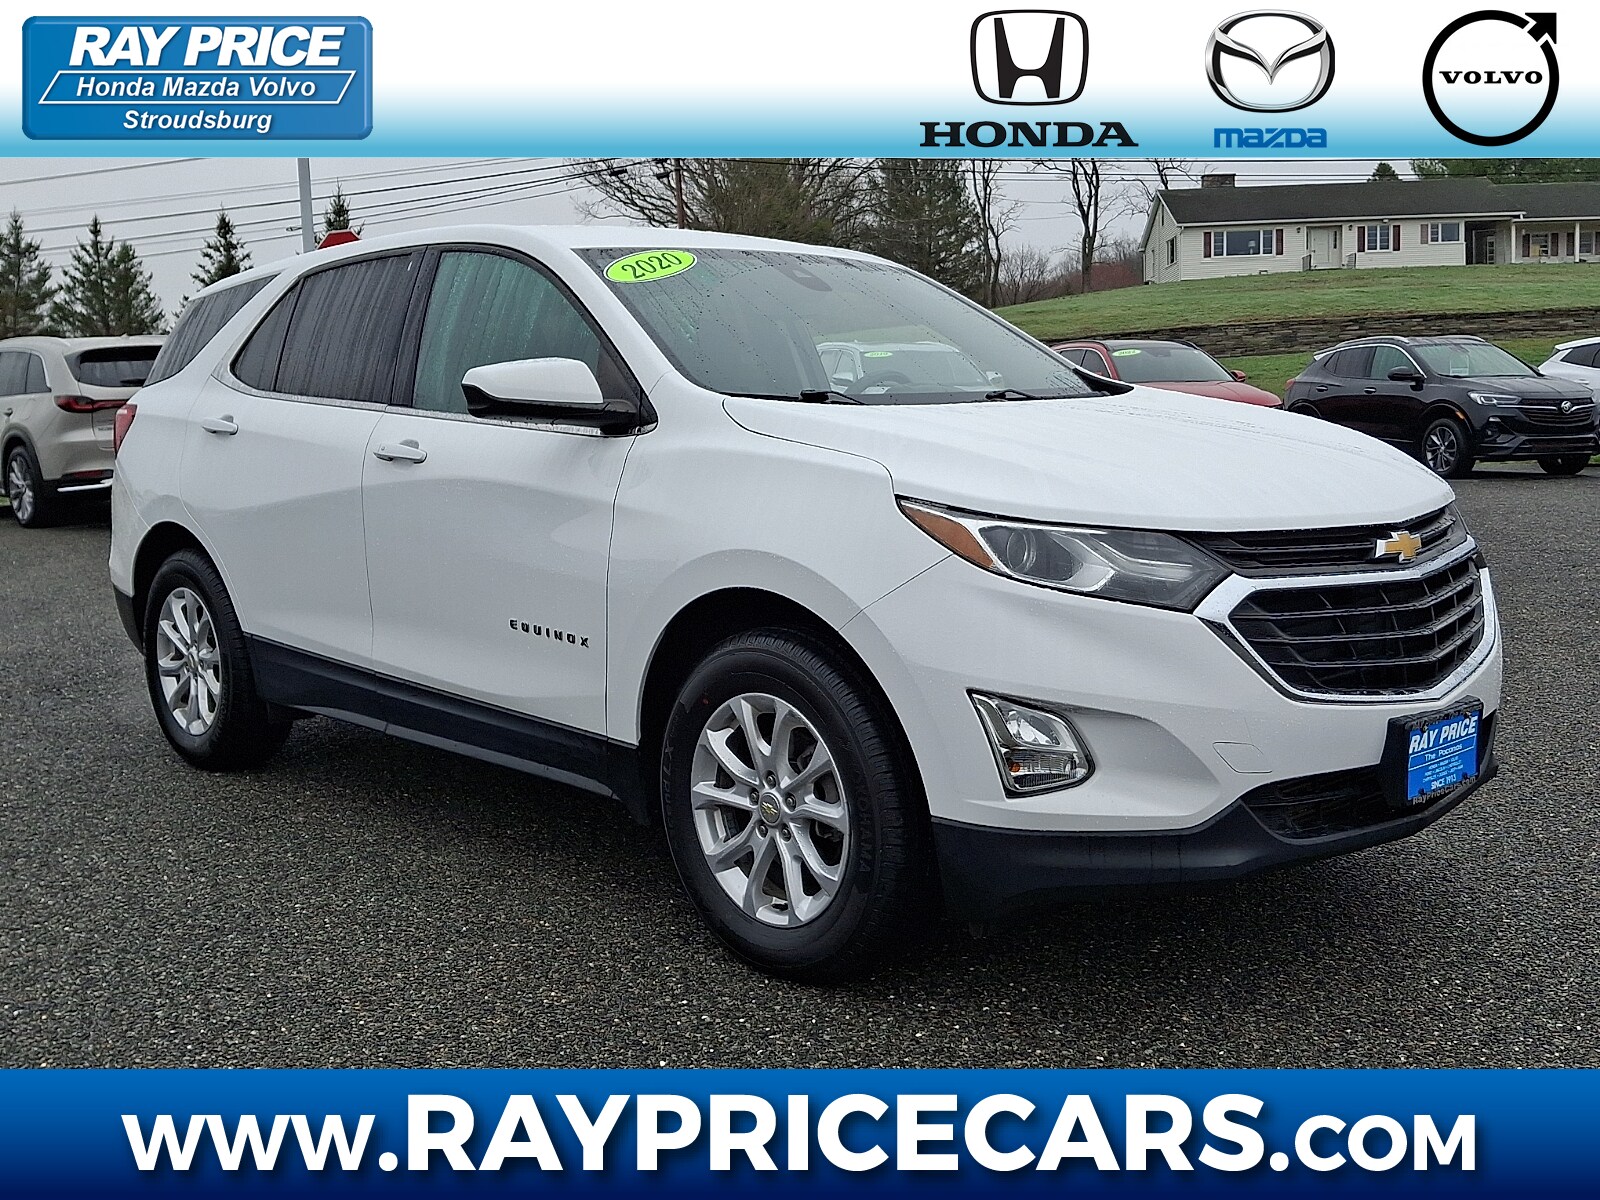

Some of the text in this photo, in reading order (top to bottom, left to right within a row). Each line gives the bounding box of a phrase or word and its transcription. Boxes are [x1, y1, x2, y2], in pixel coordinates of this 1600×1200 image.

[621, 252, 682, 279] 2020
[509, 619, 589, 648] EQUINOX
[1409, 715, 1478, 754] RAY PRICE
[1425, 744, 1462, 762] The Poconos
